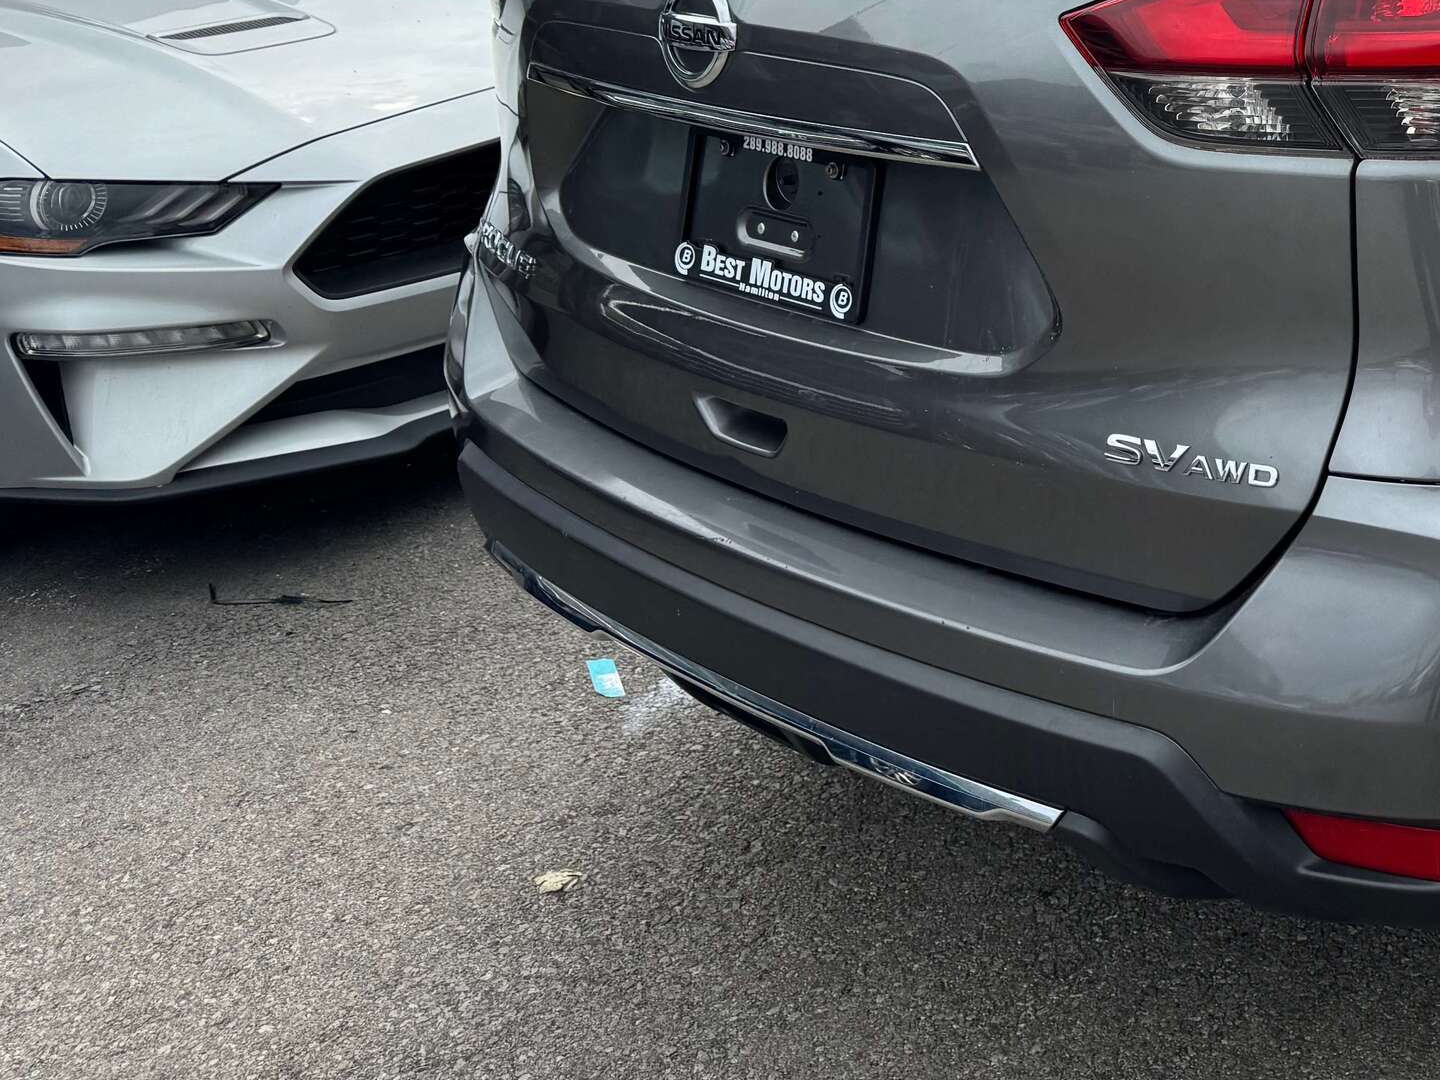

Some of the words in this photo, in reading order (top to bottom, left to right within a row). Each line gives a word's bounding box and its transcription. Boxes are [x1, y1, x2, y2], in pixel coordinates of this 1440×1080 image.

[743, 135, 813, 162] 289.988.8088
[700, 244, 746, 281] BEST
[749, 257, 826, 303] MOTORS
[738, 282, 780, 302] Hamilton
[1103, 433, 1190, 472] SV
[1184, 455, 1280, 488] AWD
